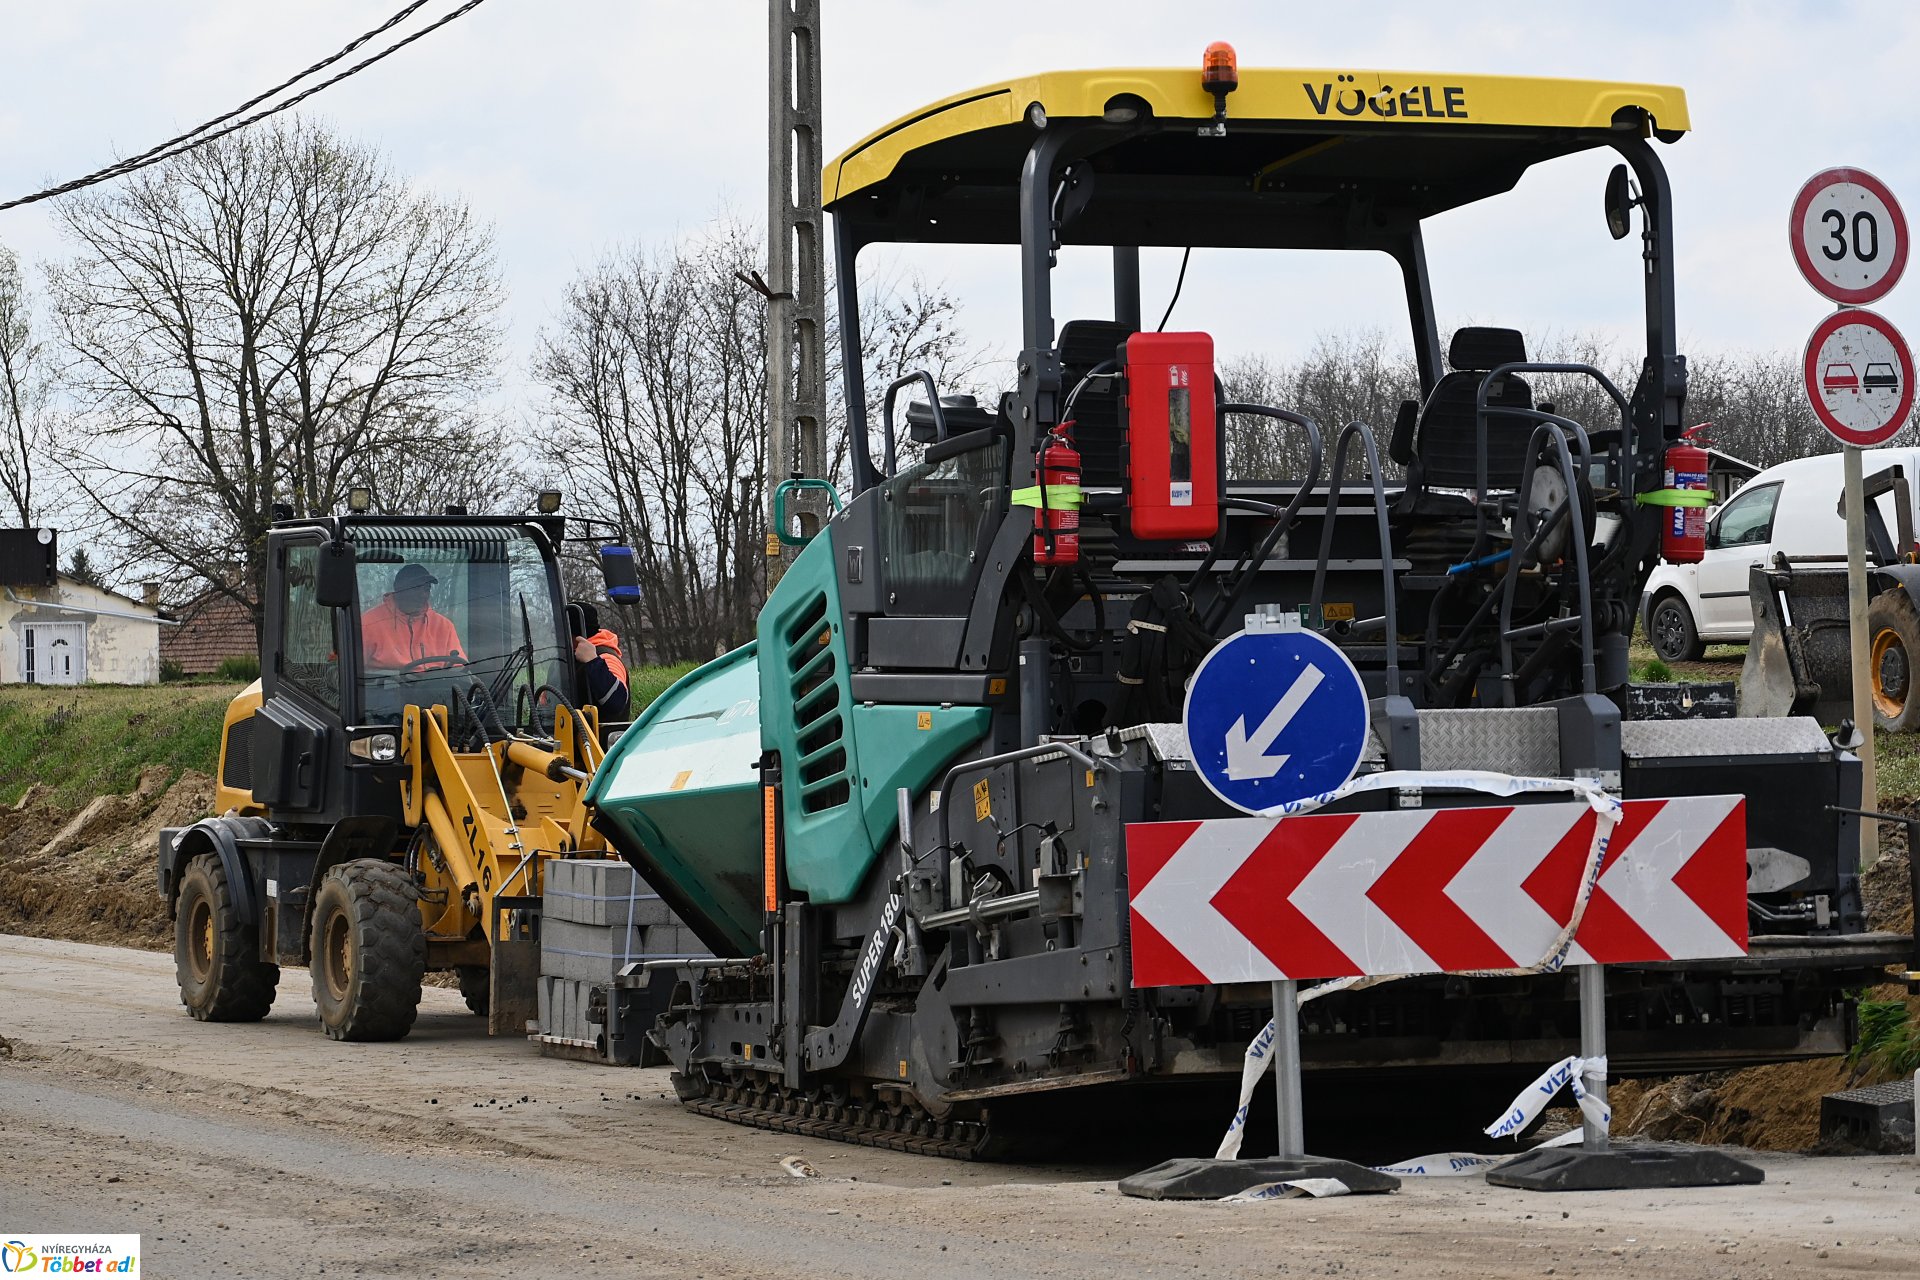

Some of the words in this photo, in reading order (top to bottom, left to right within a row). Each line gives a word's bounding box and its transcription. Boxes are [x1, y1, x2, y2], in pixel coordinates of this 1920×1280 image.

[1303, 75, 1469, 118] VÖGELE
[1821, 208, 1879, 263] 30
[462, 803, 492, 893] ZL16
[852, 929, 885, 1009] SUPER
